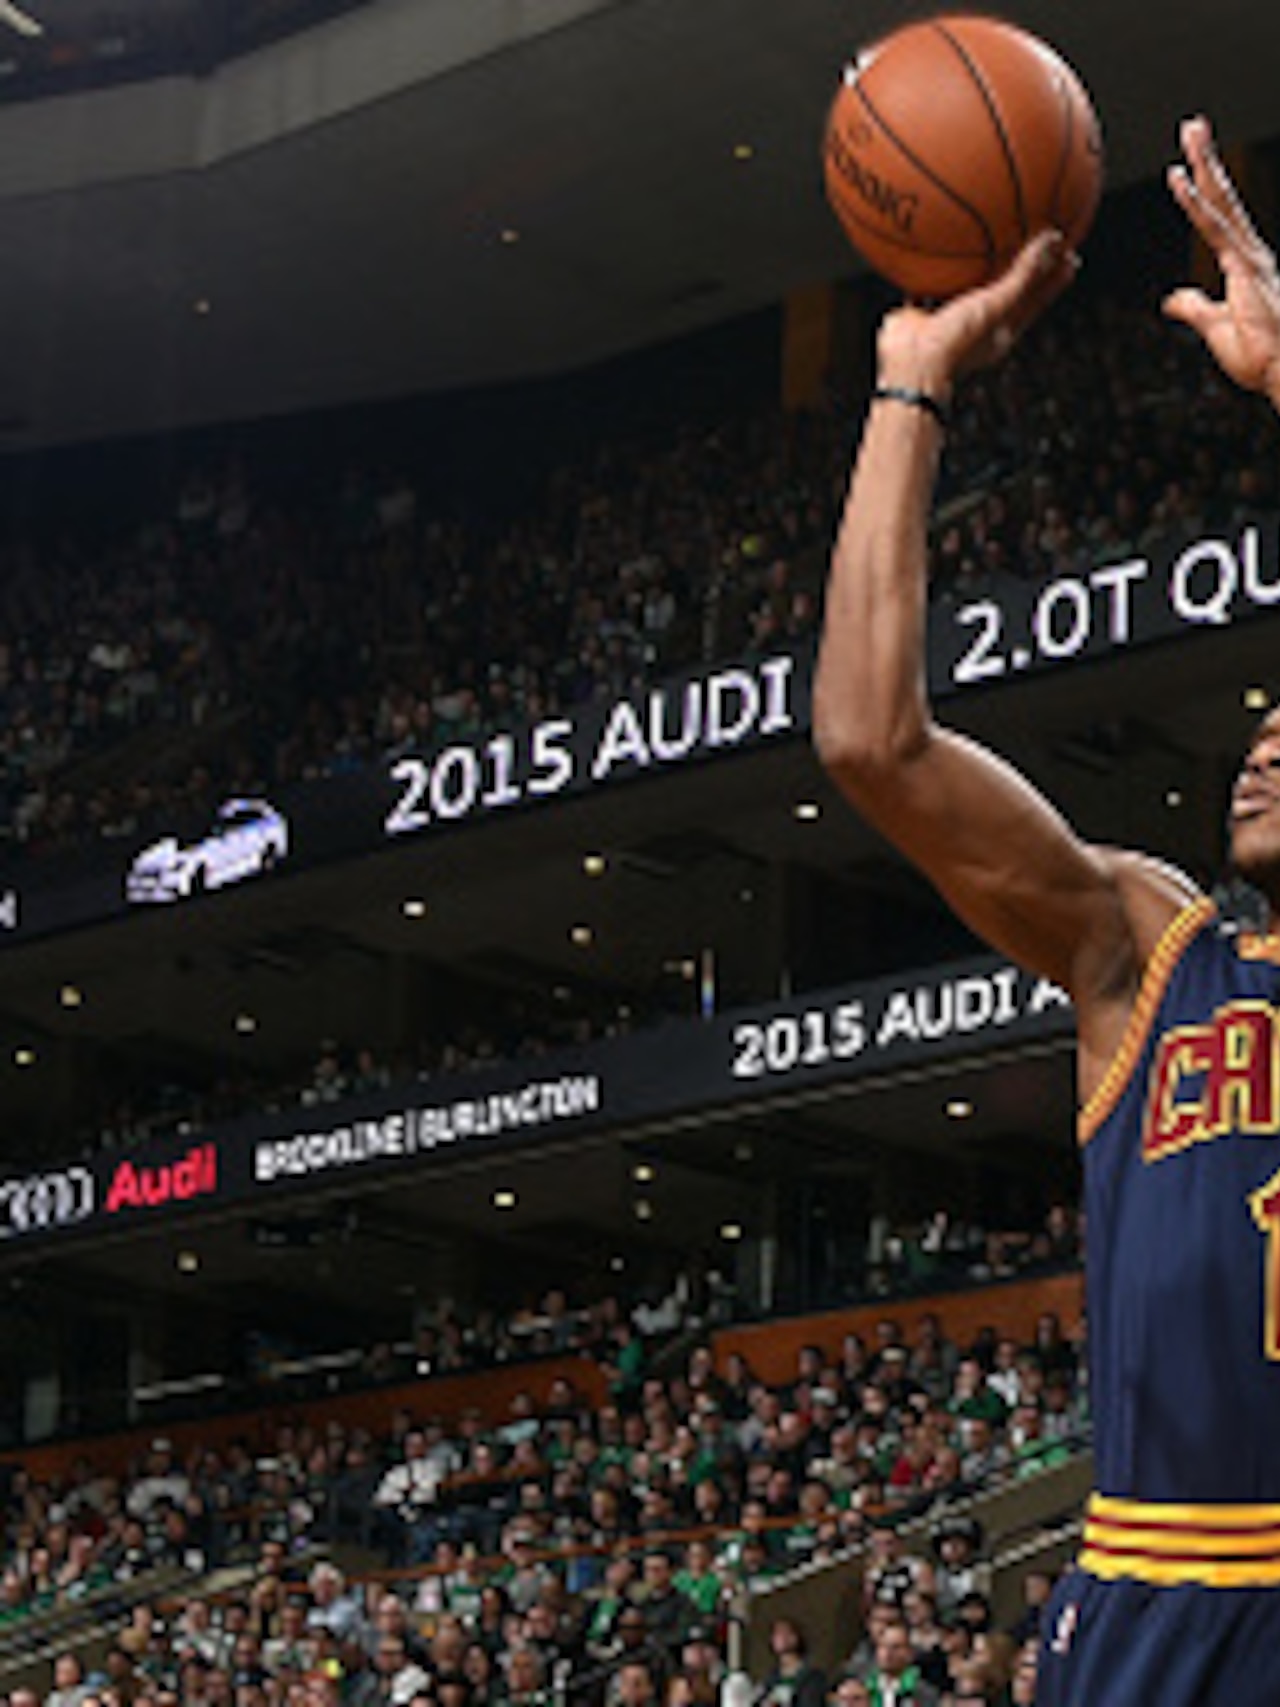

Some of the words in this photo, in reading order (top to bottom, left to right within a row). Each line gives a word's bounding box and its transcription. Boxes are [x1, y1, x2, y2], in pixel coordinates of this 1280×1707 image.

[385, 720, 573, 833] 2015
[591, 656, 793, 779] AUDI
[953, 559, 1148, 682] 2.0T
[733, 1002, 866, 1077] 2015
[876, 969, 1017, 1046] AUDI
[106, 1143, 216, 1213] Audi
